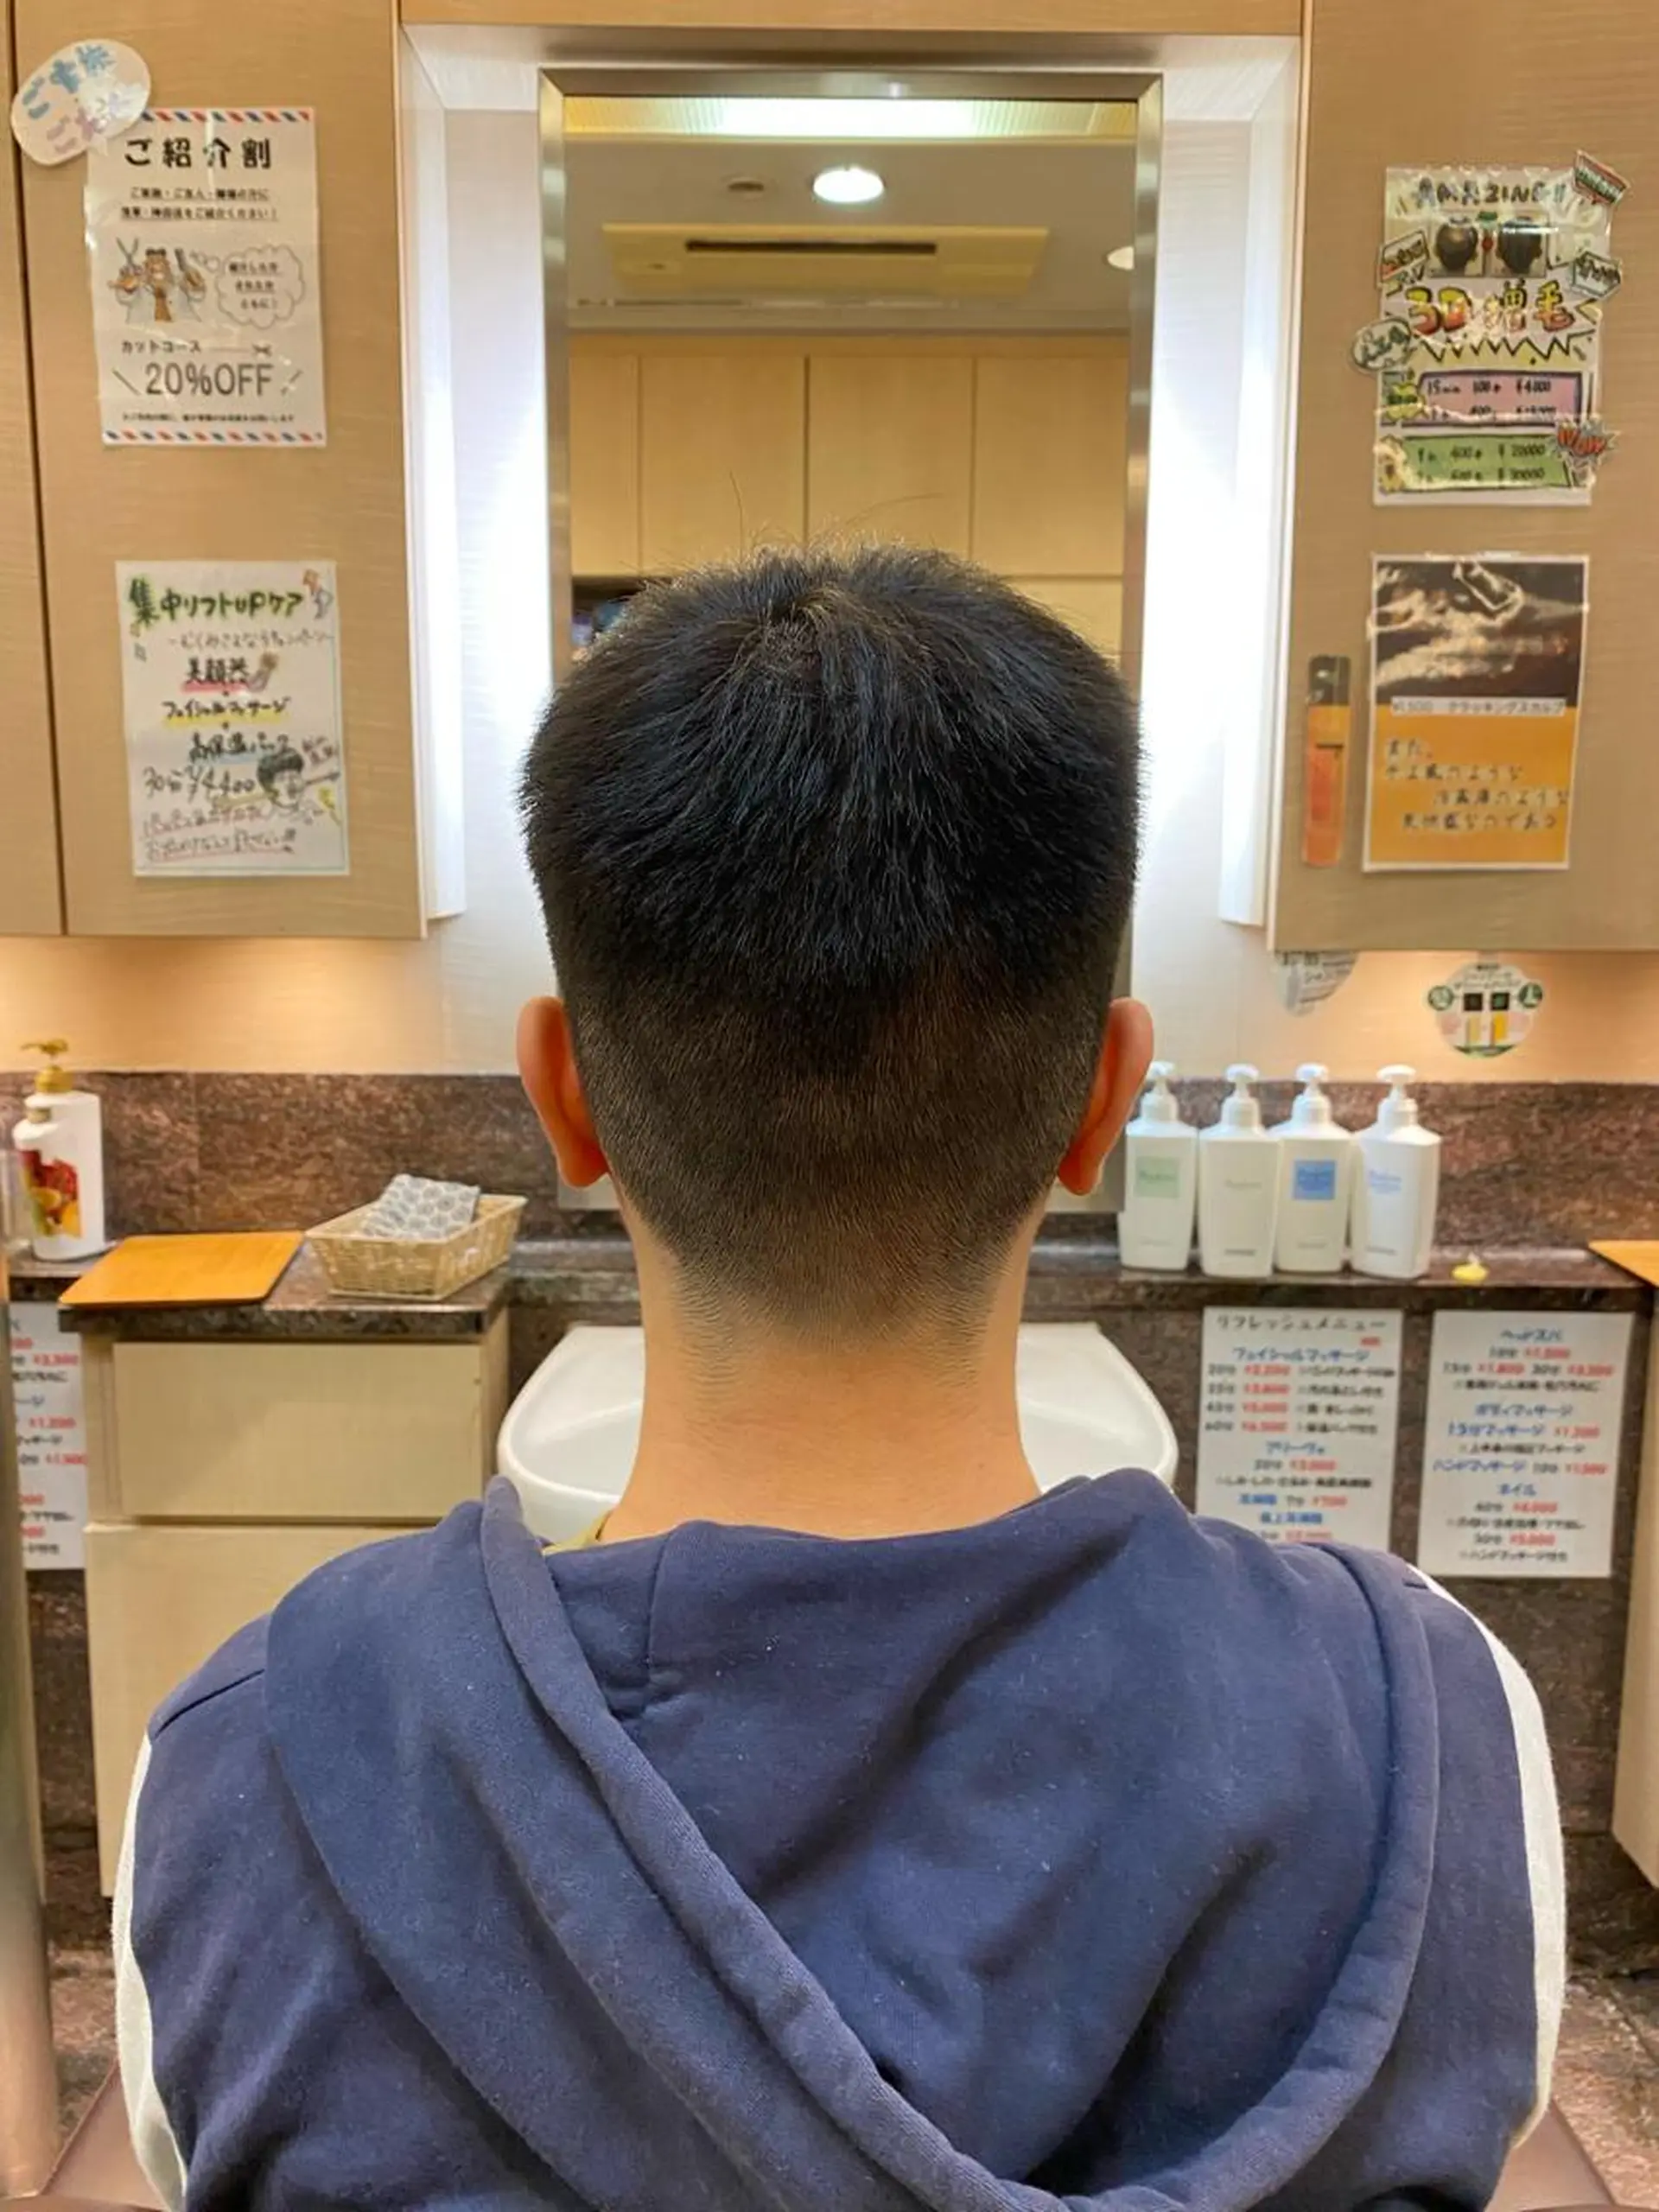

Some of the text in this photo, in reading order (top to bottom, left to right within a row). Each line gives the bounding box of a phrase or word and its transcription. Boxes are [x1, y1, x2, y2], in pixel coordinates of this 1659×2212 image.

[124, 137, 271, 168] ご紹介割
[144, 361, 274, 397] 20%OFF
